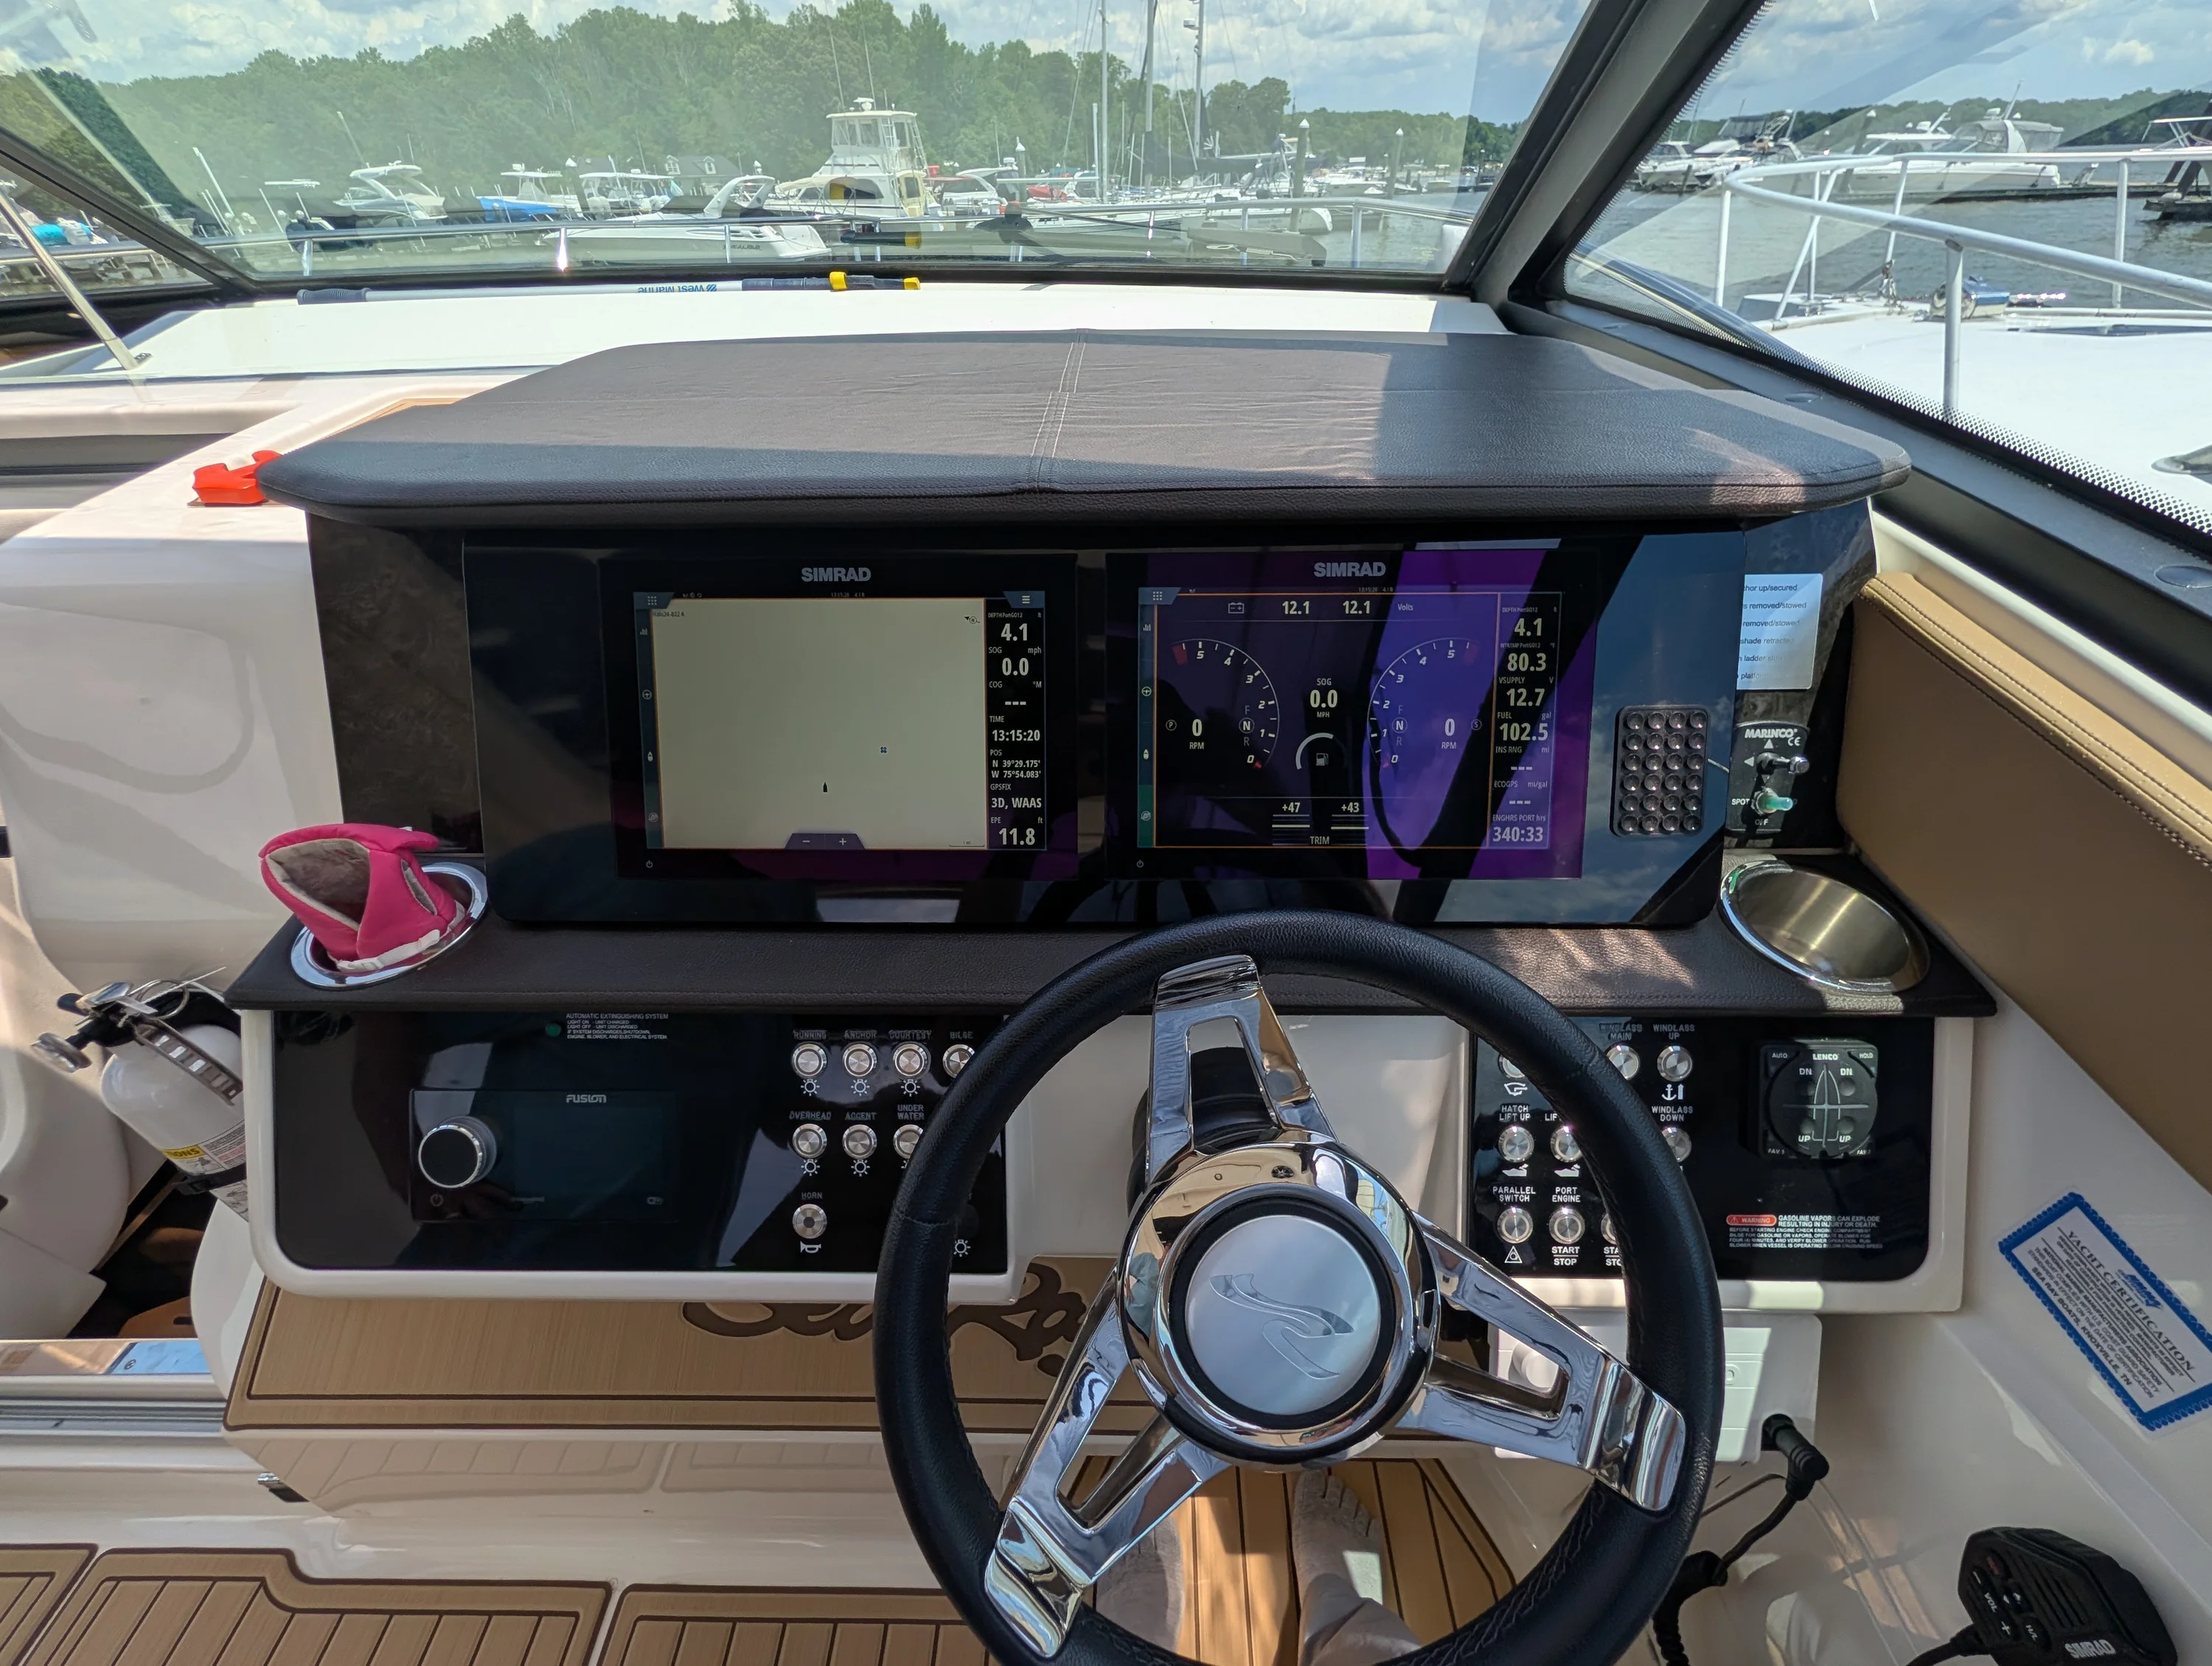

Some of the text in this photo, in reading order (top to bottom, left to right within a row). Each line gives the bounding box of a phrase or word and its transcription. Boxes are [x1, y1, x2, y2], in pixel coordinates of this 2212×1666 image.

[1313, 562, 1386, 577] SIMRAD
[801, 567, 871, 582] SIMRAD
[1759, 584, 1798, 592] up/secured
[1282, 601, 1310, 614] 12.1
[1343, 600, 1371, 614] 12.1
[1514, 618, 1543, 636] 4.1
[1001, 623, 1027, 641] 4.1
[1028, 647, 1041, 655] mph
[1197, 650, 1204, 659] 5
[1447, 650, 1455, 658] 5
[1224, 657, 1231, 665] 4
[1419, 656, 1427, 664] 4
[1507, 653, 1546, 672] 80.3
[1002, 658, 1029, 676] 0.0
[1245, 675, 1253, 683] 3
[1317, 678, 1332, 686] SOG
[1397, 675, 1404, 683] 3
[1310, 690, 1338, 708] 0.0
[1506, 688, 1545, 707] 12.7
[1259, 701, 1265, 709] 2
[1245, 706, 1250, 715] F
[1399, 706, 1403, 714] F
[1542, 712, 1551, 721] gal
[1192, 719, 1203, 736] 0
[1243, 721, 1250, 730] N
[1396, 721, 1403, 730] N
[1445, 718, 1455, 736] 0
[992, 729, 1040, 741] 13:15:20
[1260, 729, 1265, 737] 1
[1382, 729, 1387, 737] 1
[1500, 723, 1548, 741] 102.5
[1745, 729, 1795, 738] MARINCO
[1244, 737, 1250, 746] R
[1397, 737, 1402, 746] R
[1787, 737, 1801, 746] CE
[1247, 755, 1254, 763] 0
[1391, 755, 1398, 763] 0
[1527, 780, 1548, 789] mi/gal
[992, 798, 1041, 809] 3D, WAAS
[1282, 802, 1360, 813] +47 +43
[999, 828, 1034, 845] 11.8
[1492, 827, 1543, 842] 340:33
[1310, 836, 1329, 844] TRIM
[1599, 1024, 1642, 1032] WINDLASS
[793, 1031, 827, 1039] RUNNING
[844, 1031, 876, 1039] ANCHOR
[889, 1031, 931, 1039] COURTESY
[1652, 1106, 1693, 1114] WINDLASS
[789, 1111, 831, 1120] OVERHEAD
[845, 1112, 876, 1120] ACCENT
[897, 1112, 924, 1120] WATER
[1499, 1194, 1530, 1202] SWITCH
[1552, 1195, 1581, 1203] ENGINE
[2067, 1230, 2105, 1269] YACHT
[2103, 1270, 2196, 1371] CERTIFICATION
[2041, 1246, 2066, 1273] NATIONAL
[2064, 1272, 2084, 1294] MARINE
[2081, 1294, 2128, 1345] MANUFACTURERS
[2124, 1344, 2163, 1386] ASSOCIATION
[2031, 1266, 2046, 1283] SEA
[2043, 1281, 2059, 1298] RAY
[2120, 1373, 2132, 1386] TN
[1984, 1592, 1997, 1613] VOL
[2065, 1639, 2116, 1658] SIMRAD
